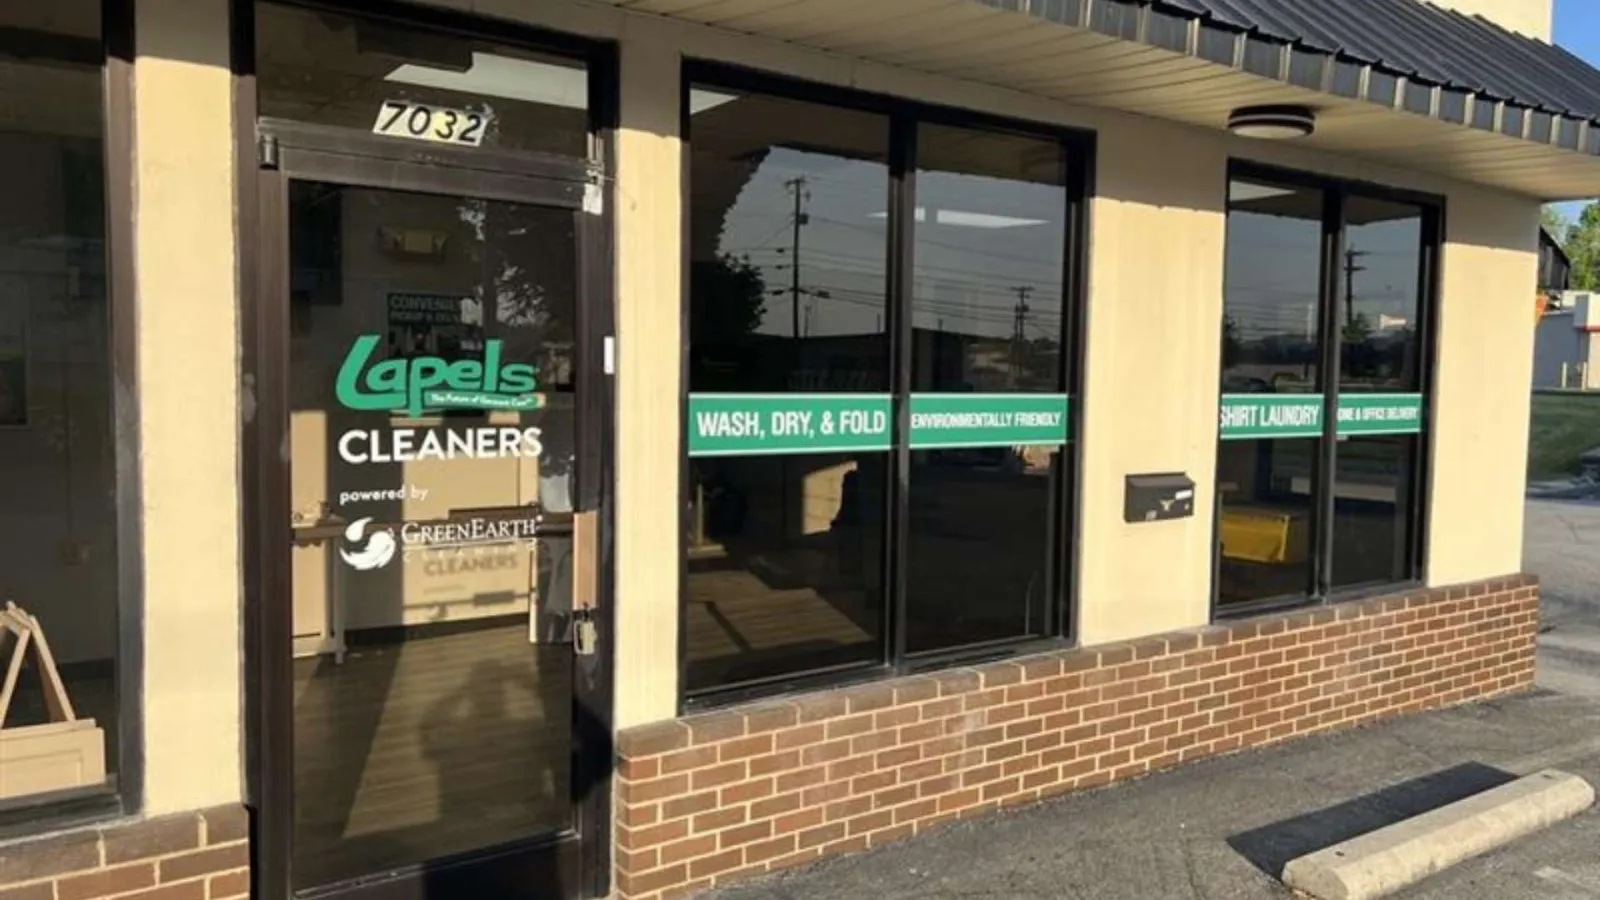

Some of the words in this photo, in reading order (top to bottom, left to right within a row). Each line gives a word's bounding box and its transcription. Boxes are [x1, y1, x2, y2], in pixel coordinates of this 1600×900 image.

[381, 102, 481, 142] 7032
[335, 334, 537, 418] Lapels
[697, 411, 766, 440] WASH,
[771, 410, 815, 439] DRY,
[819, 409, 834, 435] &
[839, 409, 886, 434] FOLD
[910, 411, 1012, 429] ENVIRONMENTALLY
[1014, 410, 1062, 427] FRIENDLY
[1220, 404, 1257, 428] SHIRT
[1259, 403, 1320, 427] LAUNDRY
[338, 427, 543, 464] CLEANERS
[339, 485, 405, 506] powered
[411, 484, 429, 500] by
[423, 553, 518, 578] CLEANERS
